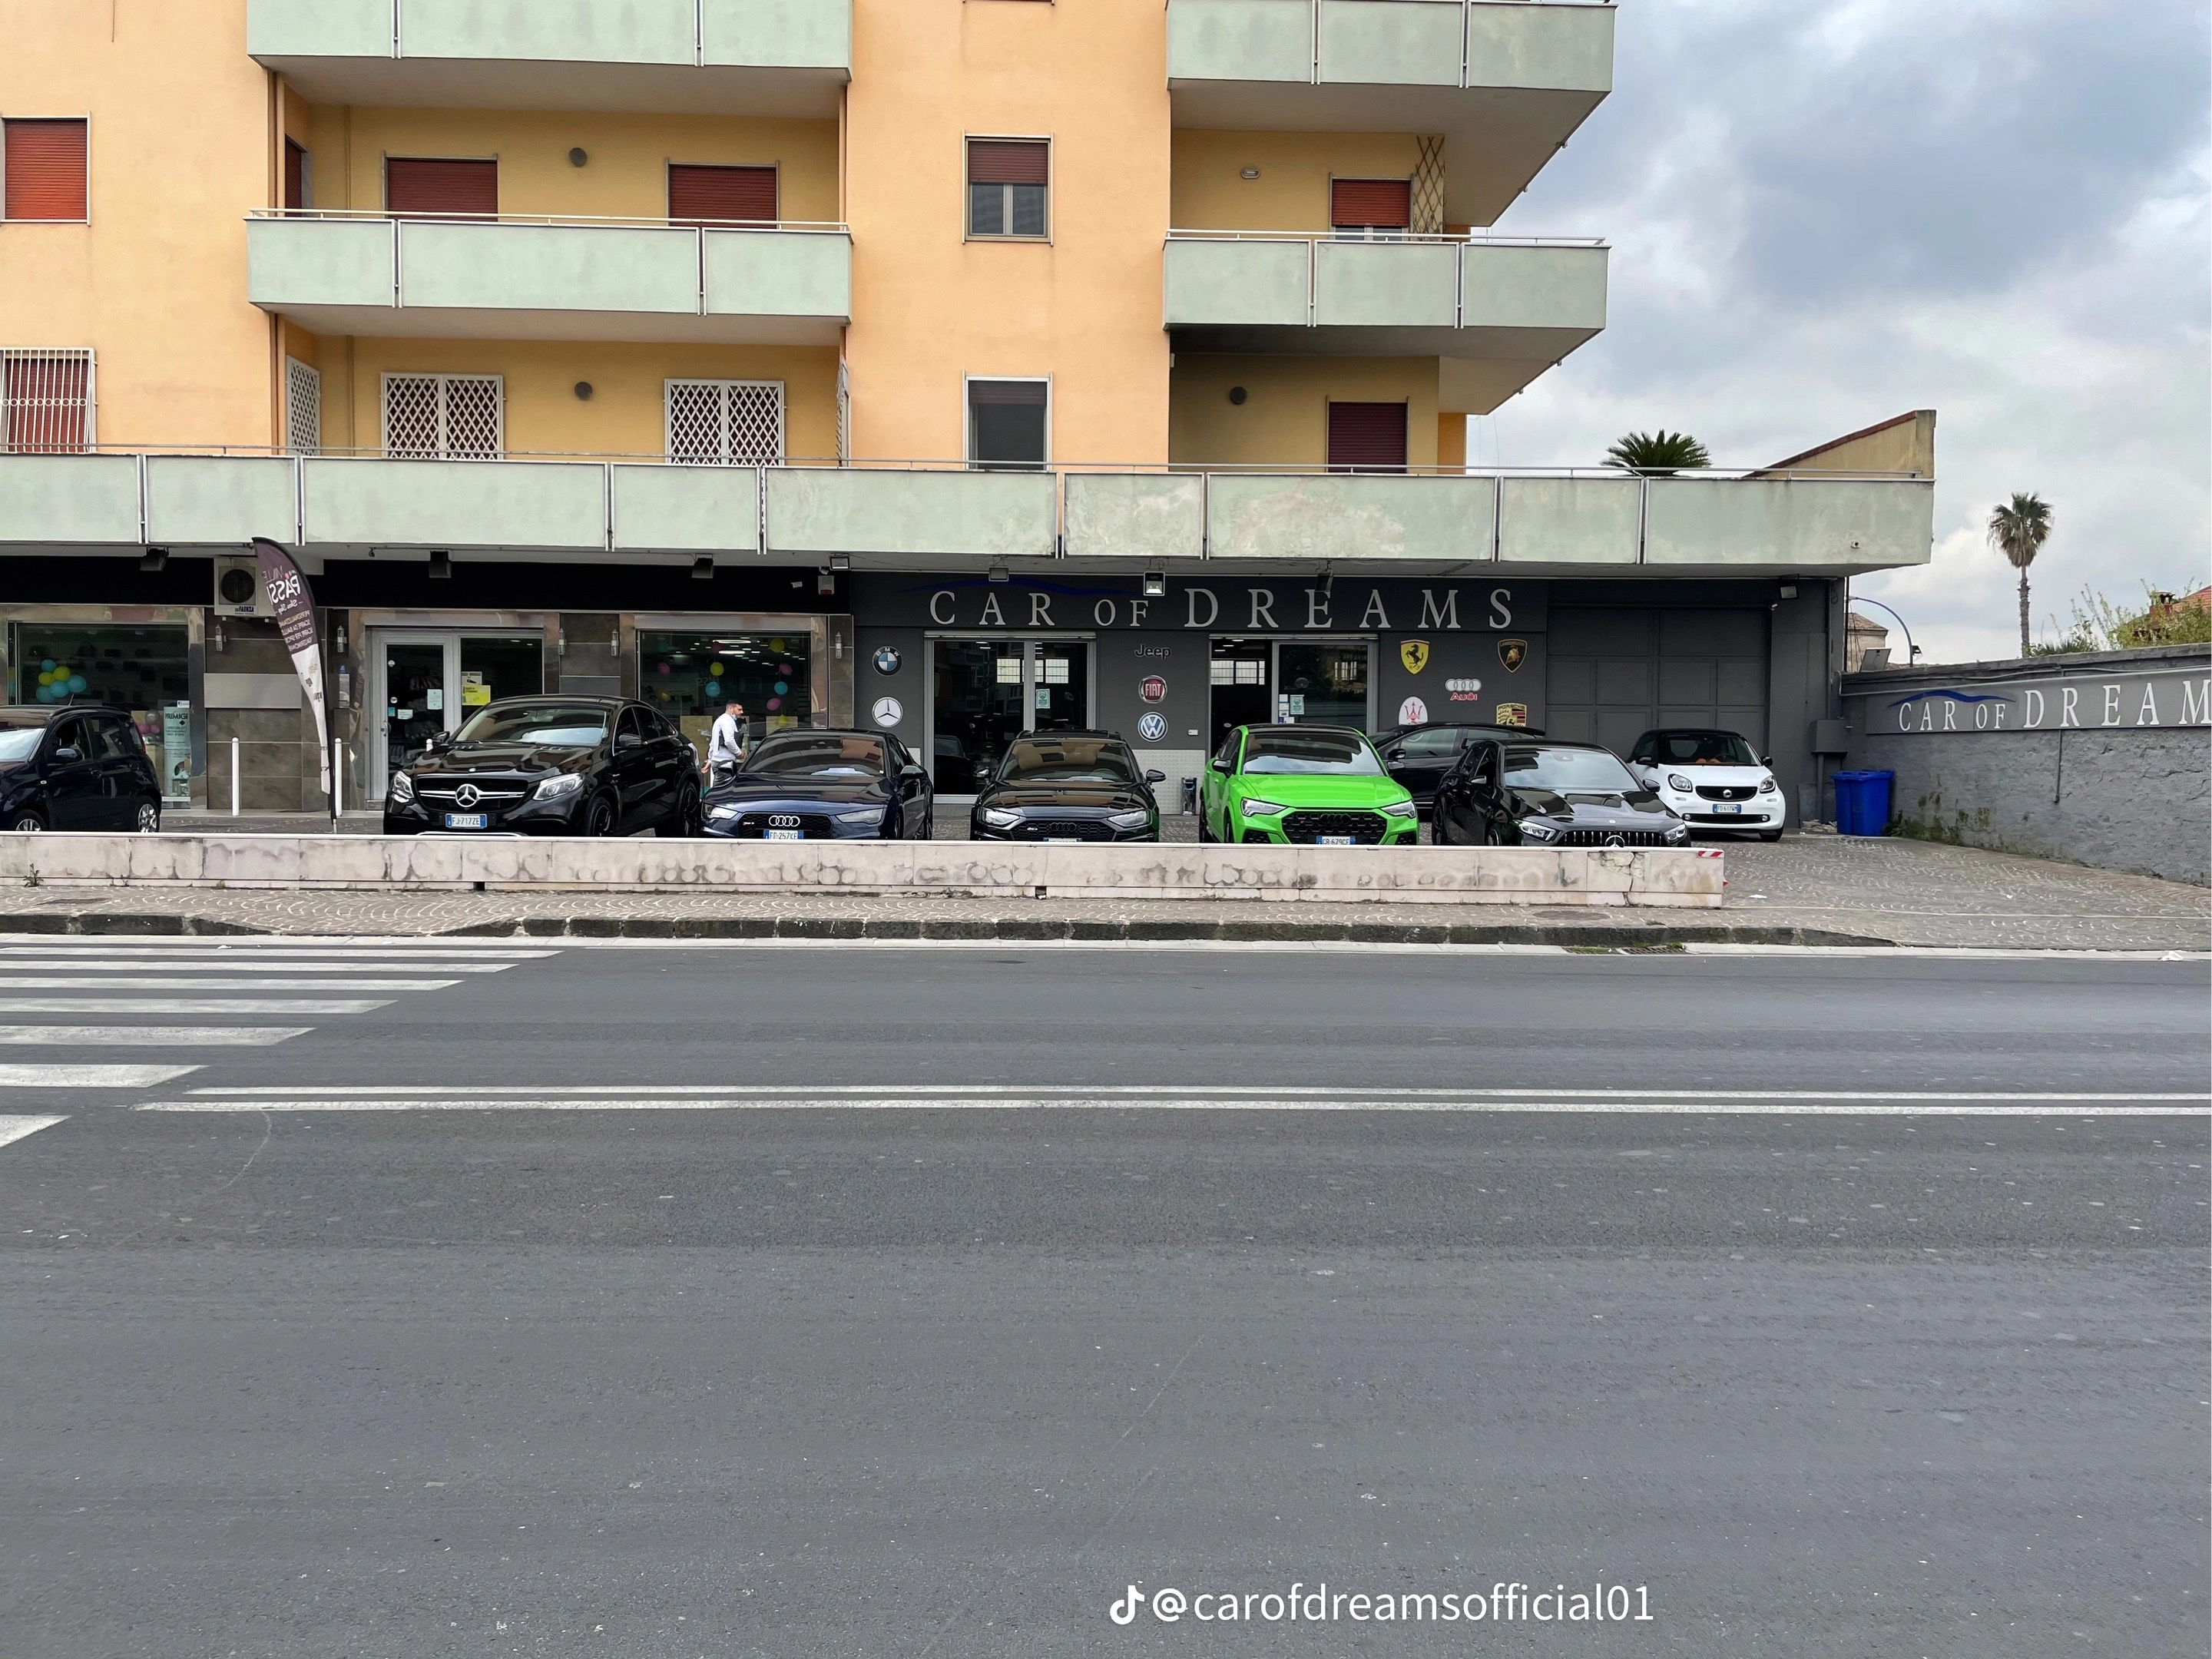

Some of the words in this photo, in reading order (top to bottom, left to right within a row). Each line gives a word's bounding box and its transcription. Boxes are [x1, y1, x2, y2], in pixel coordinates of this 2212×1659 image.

[929, 590, 1055, 626] CAR
[1094, 599, 1149, 627] OF
[1184, 588, 1512, 629] DREAMS
[876, 647, 900, 657] BMW
[1134, 644, 1171, 660] Jeep
[1145, 684, 1161, 697] FIAT
[1449, 692, 1478, 701] Audi
[1899, 700, 1957, 731] CAR
[1975, 704, 2006, 730] OF
[2023, 680, 2212, 728] DREAM
